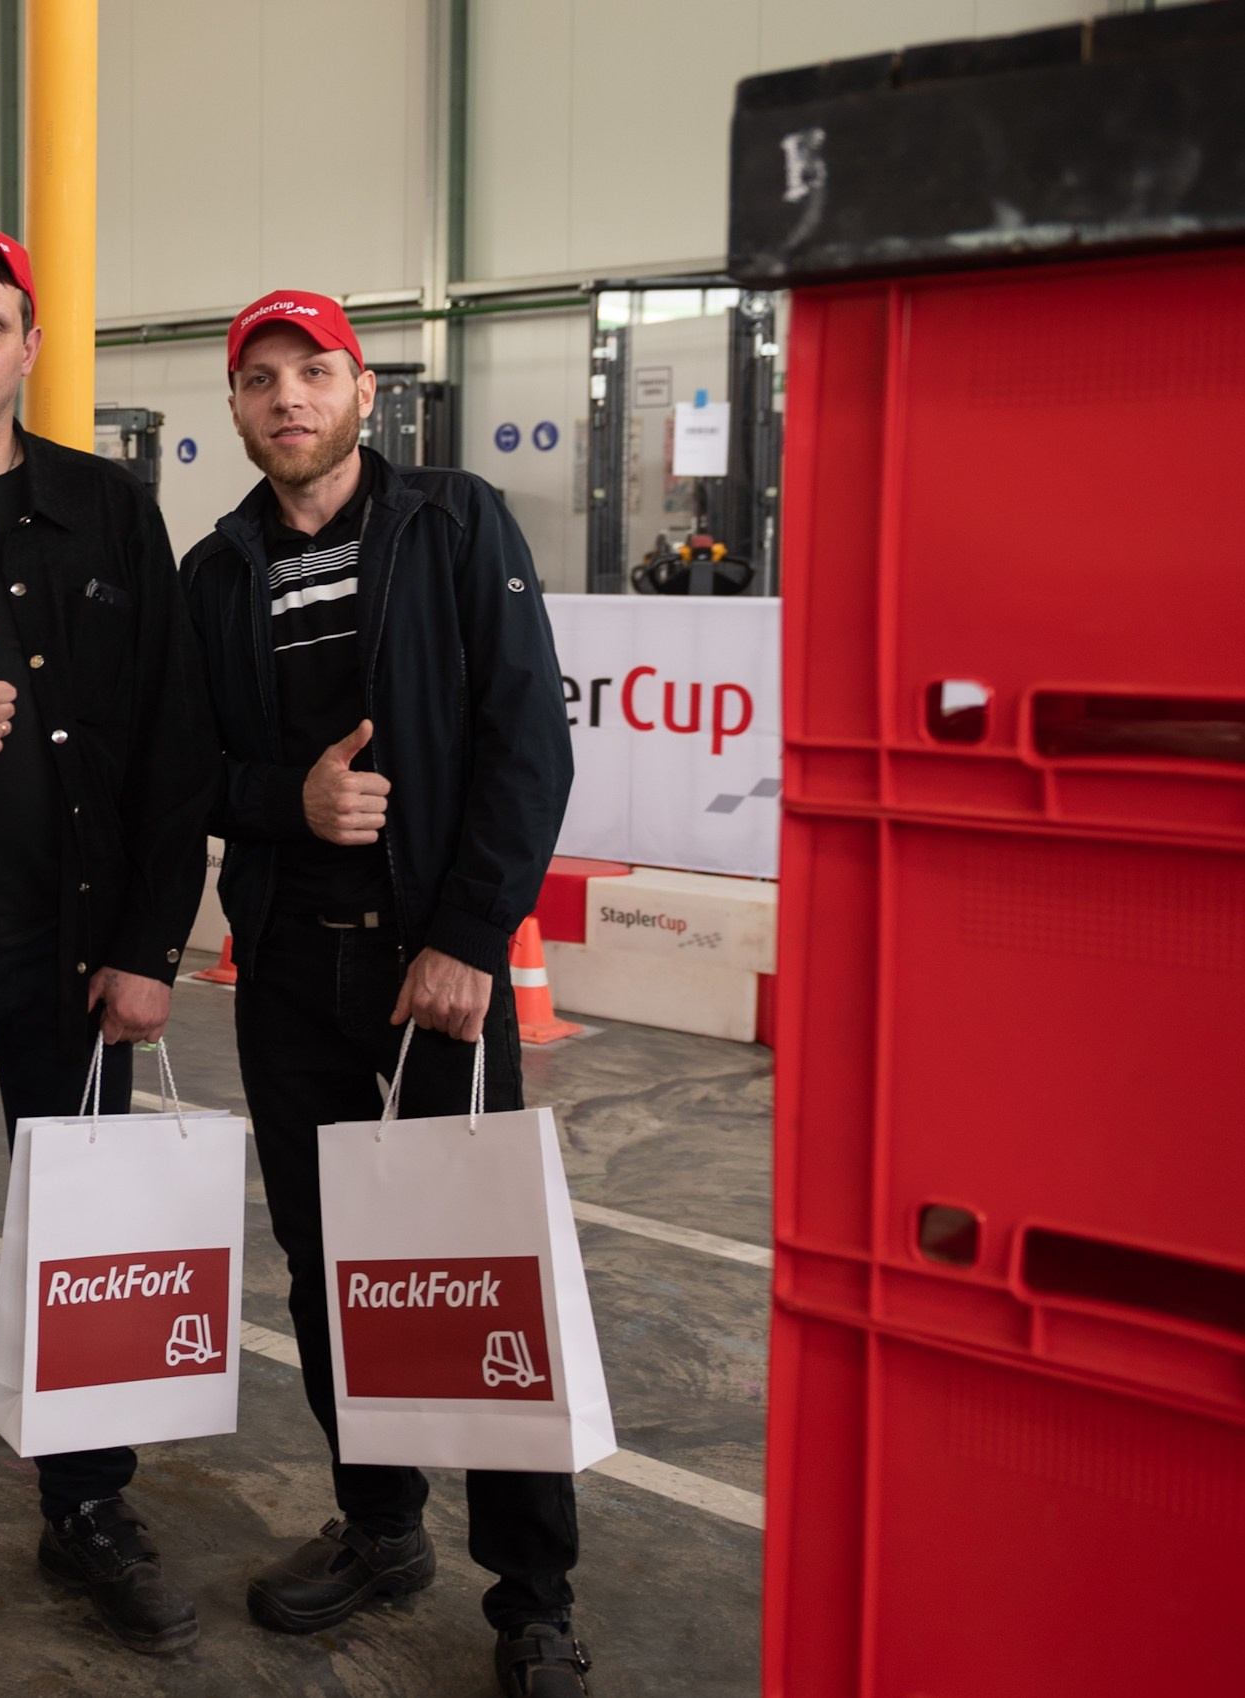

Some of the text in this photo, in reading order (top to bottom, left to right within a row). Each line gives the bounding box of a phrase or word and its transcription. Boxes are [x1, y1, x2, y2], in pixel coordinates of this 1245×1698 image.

[240, 301, 294, 330] StaplerCup
[600, 906, 687, 935] StaplerCup
[46, 1261, 194, 1306] RackFork
[347, 1270, 501, 1308] RackFork
